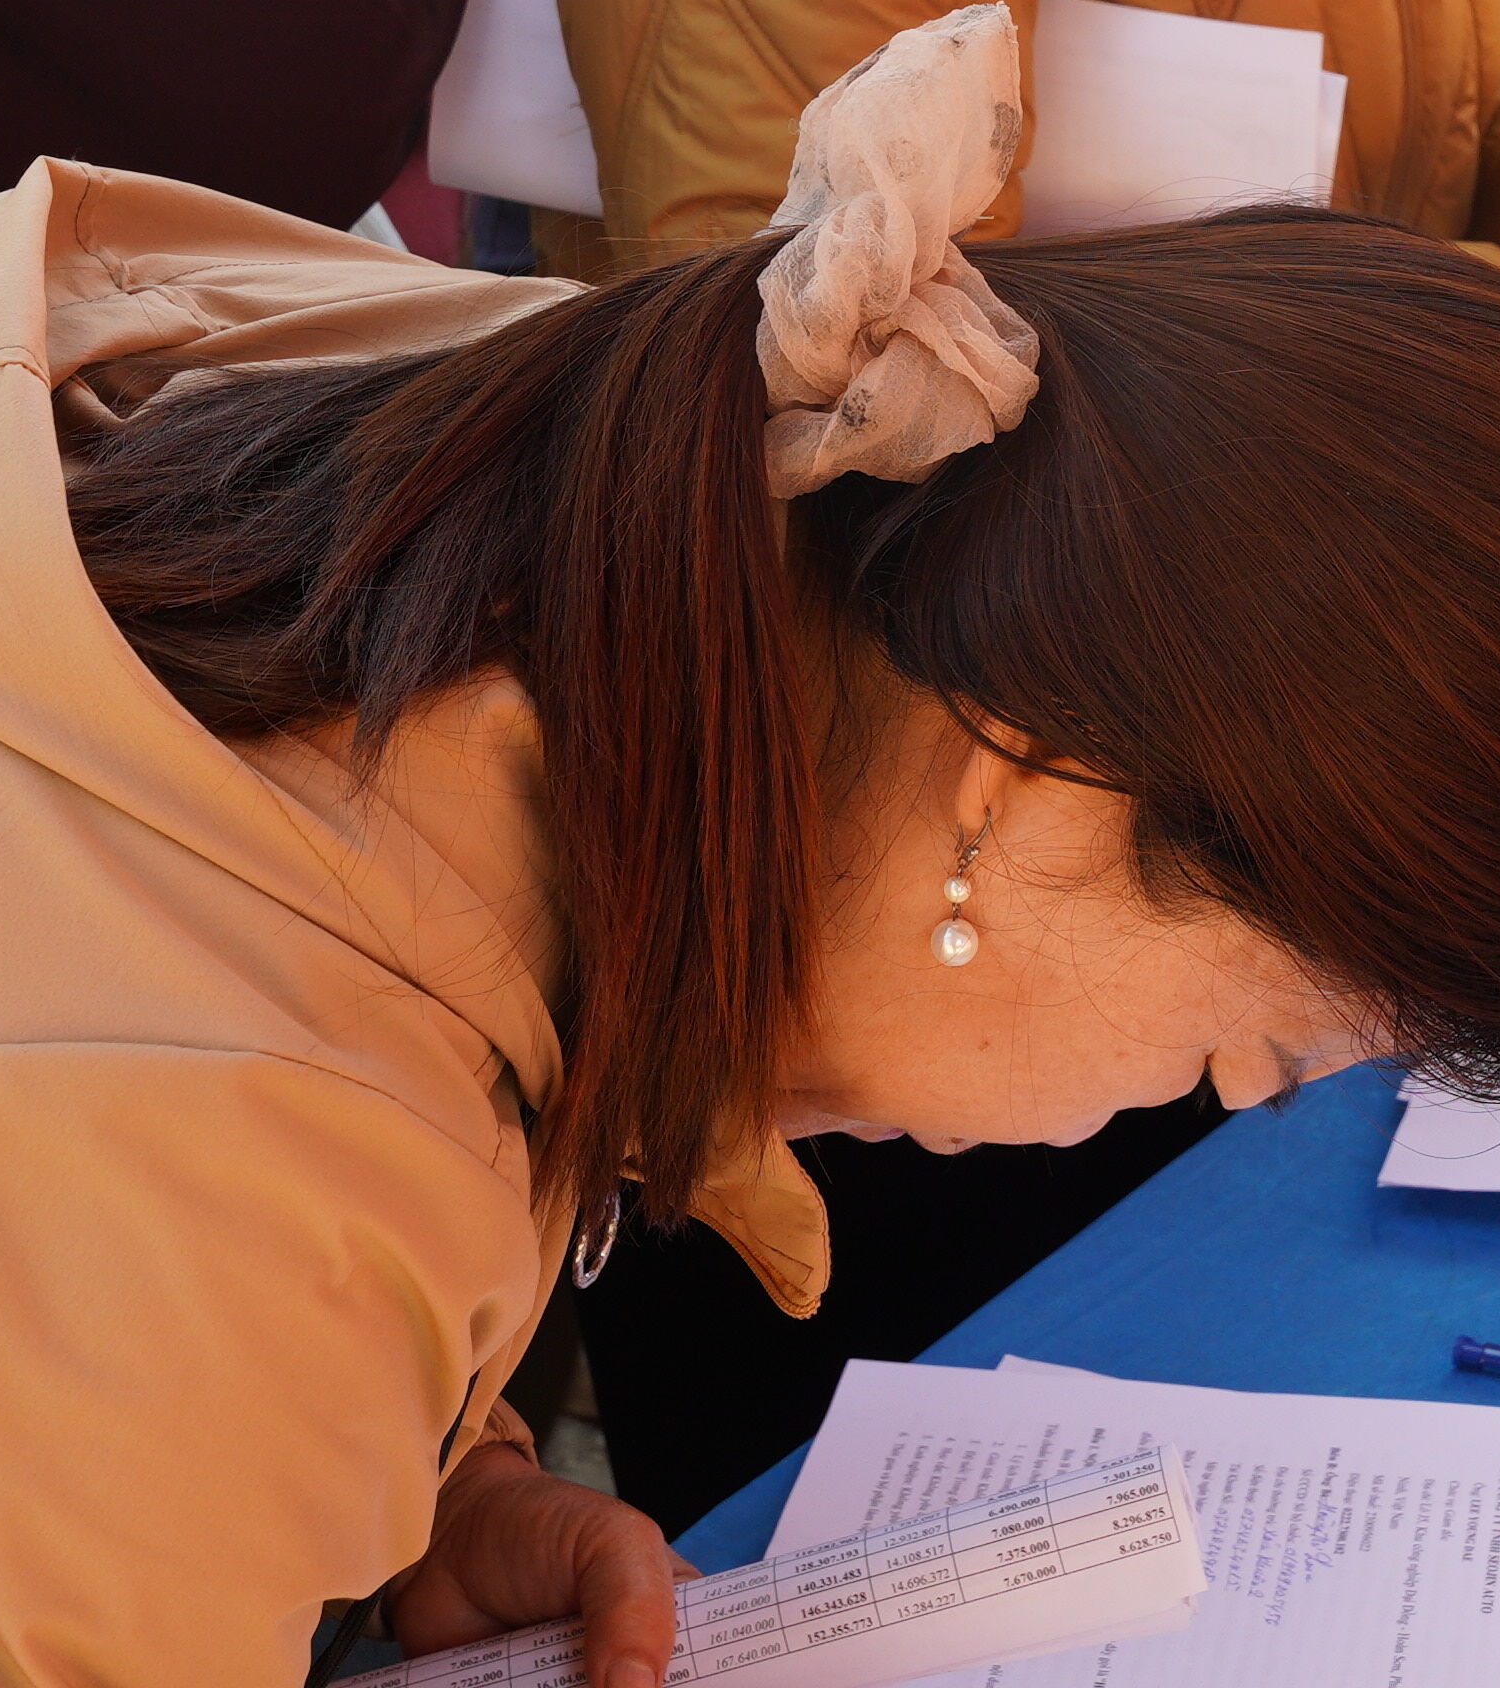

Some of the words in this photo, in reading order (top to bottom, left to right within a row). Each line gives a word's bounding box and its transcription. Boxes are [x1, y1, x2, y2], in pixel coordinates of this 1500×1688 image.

[991, 1516, 1045, 1540] 7.080.000
[1106, 1482, 1159, 1506] 7.965.000
[800, 1591, 868, 1620] 146.343.628
[891, 1568, 951, 1594] 14.696.372
[996, 1539, 1050, 1564] 7.375.000
[1112, 1506, 1167, 1531] 8.296.875
[806, 1616, 874, 1645] 152.355.773
[896, 1592, 957, 1619] 15.284.227
[1003, 1564, 1057, 1589] 7.670.000
[1118, 1531, 1173, 1555] 8.628.750
[1480, 1589, 1495, 1614] AUTO
